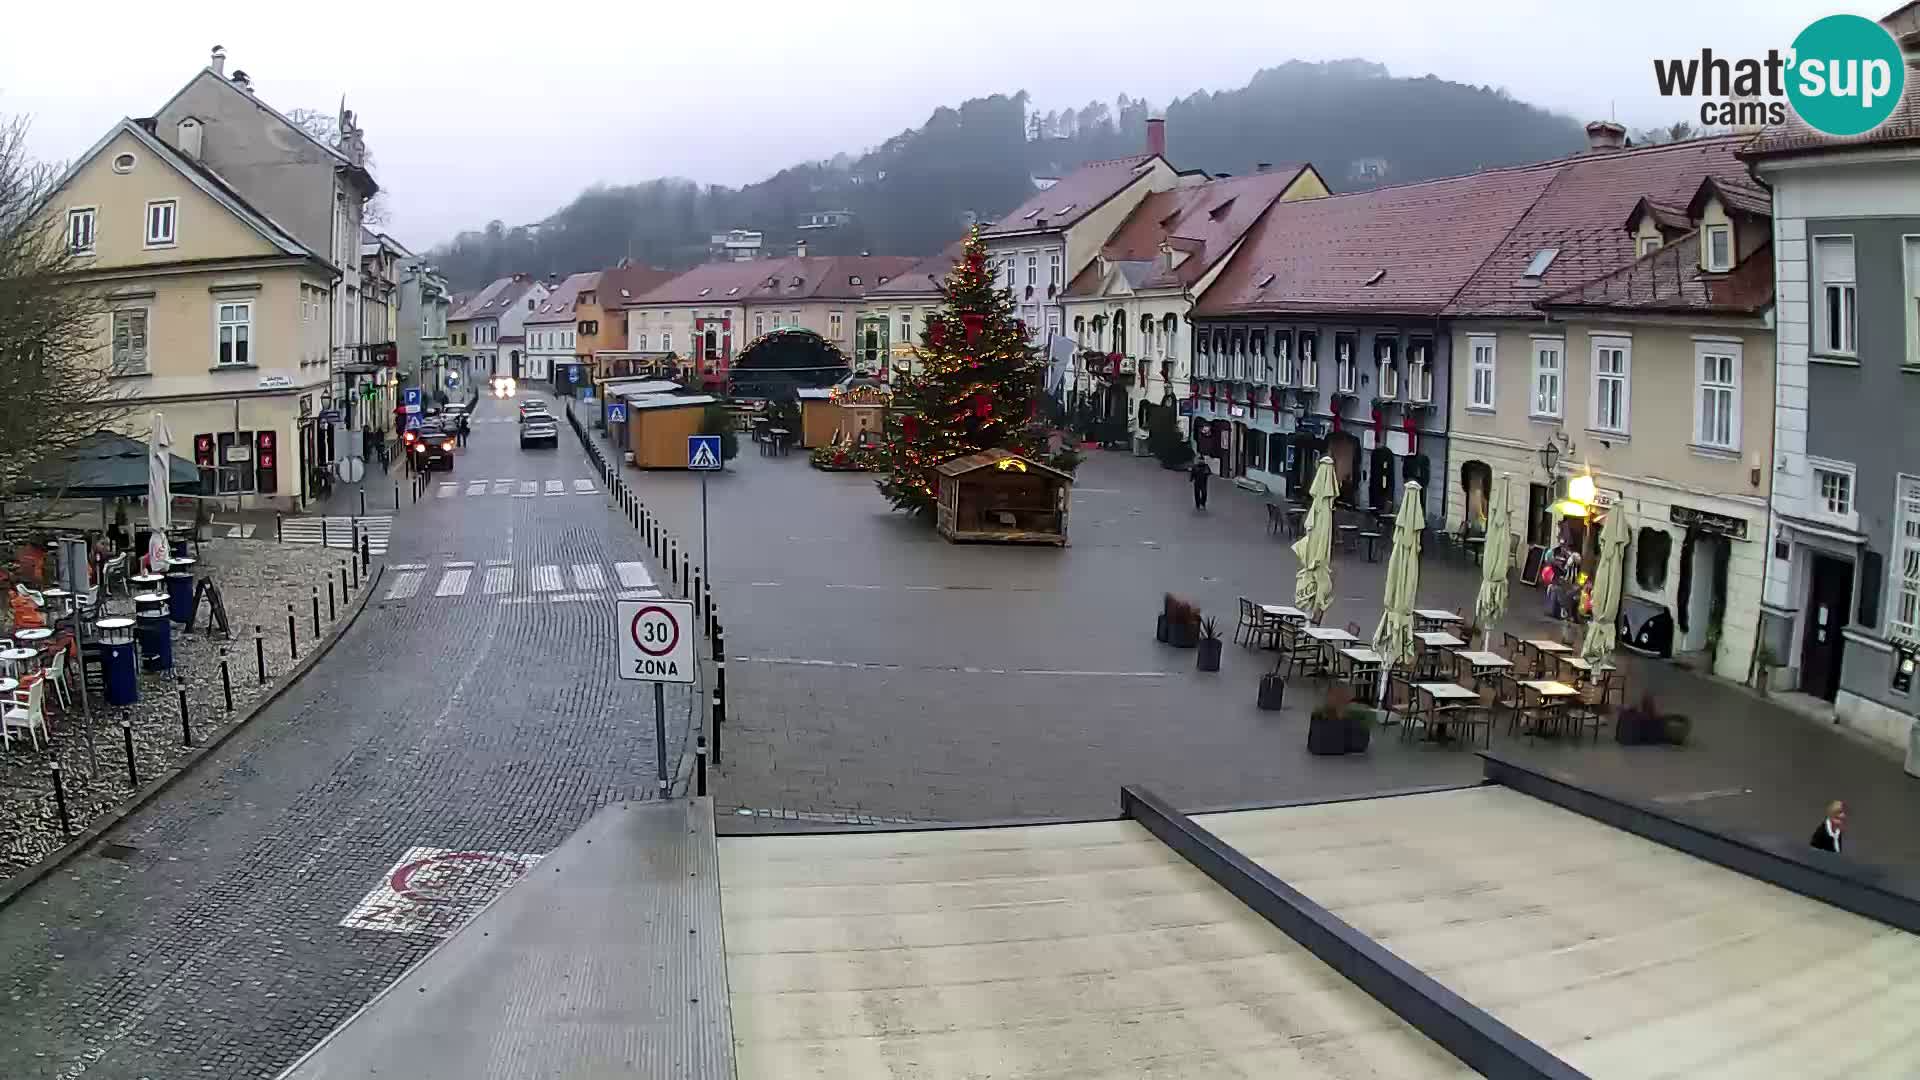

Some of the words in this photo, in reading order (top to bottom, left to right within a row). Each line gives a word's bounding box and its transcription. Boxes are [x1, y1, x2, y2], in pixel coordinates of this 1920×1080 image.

[408, 391, 416, 402] P
[644, 622, 668, 643] 30
[634, 659, 678, 676] ZONA
